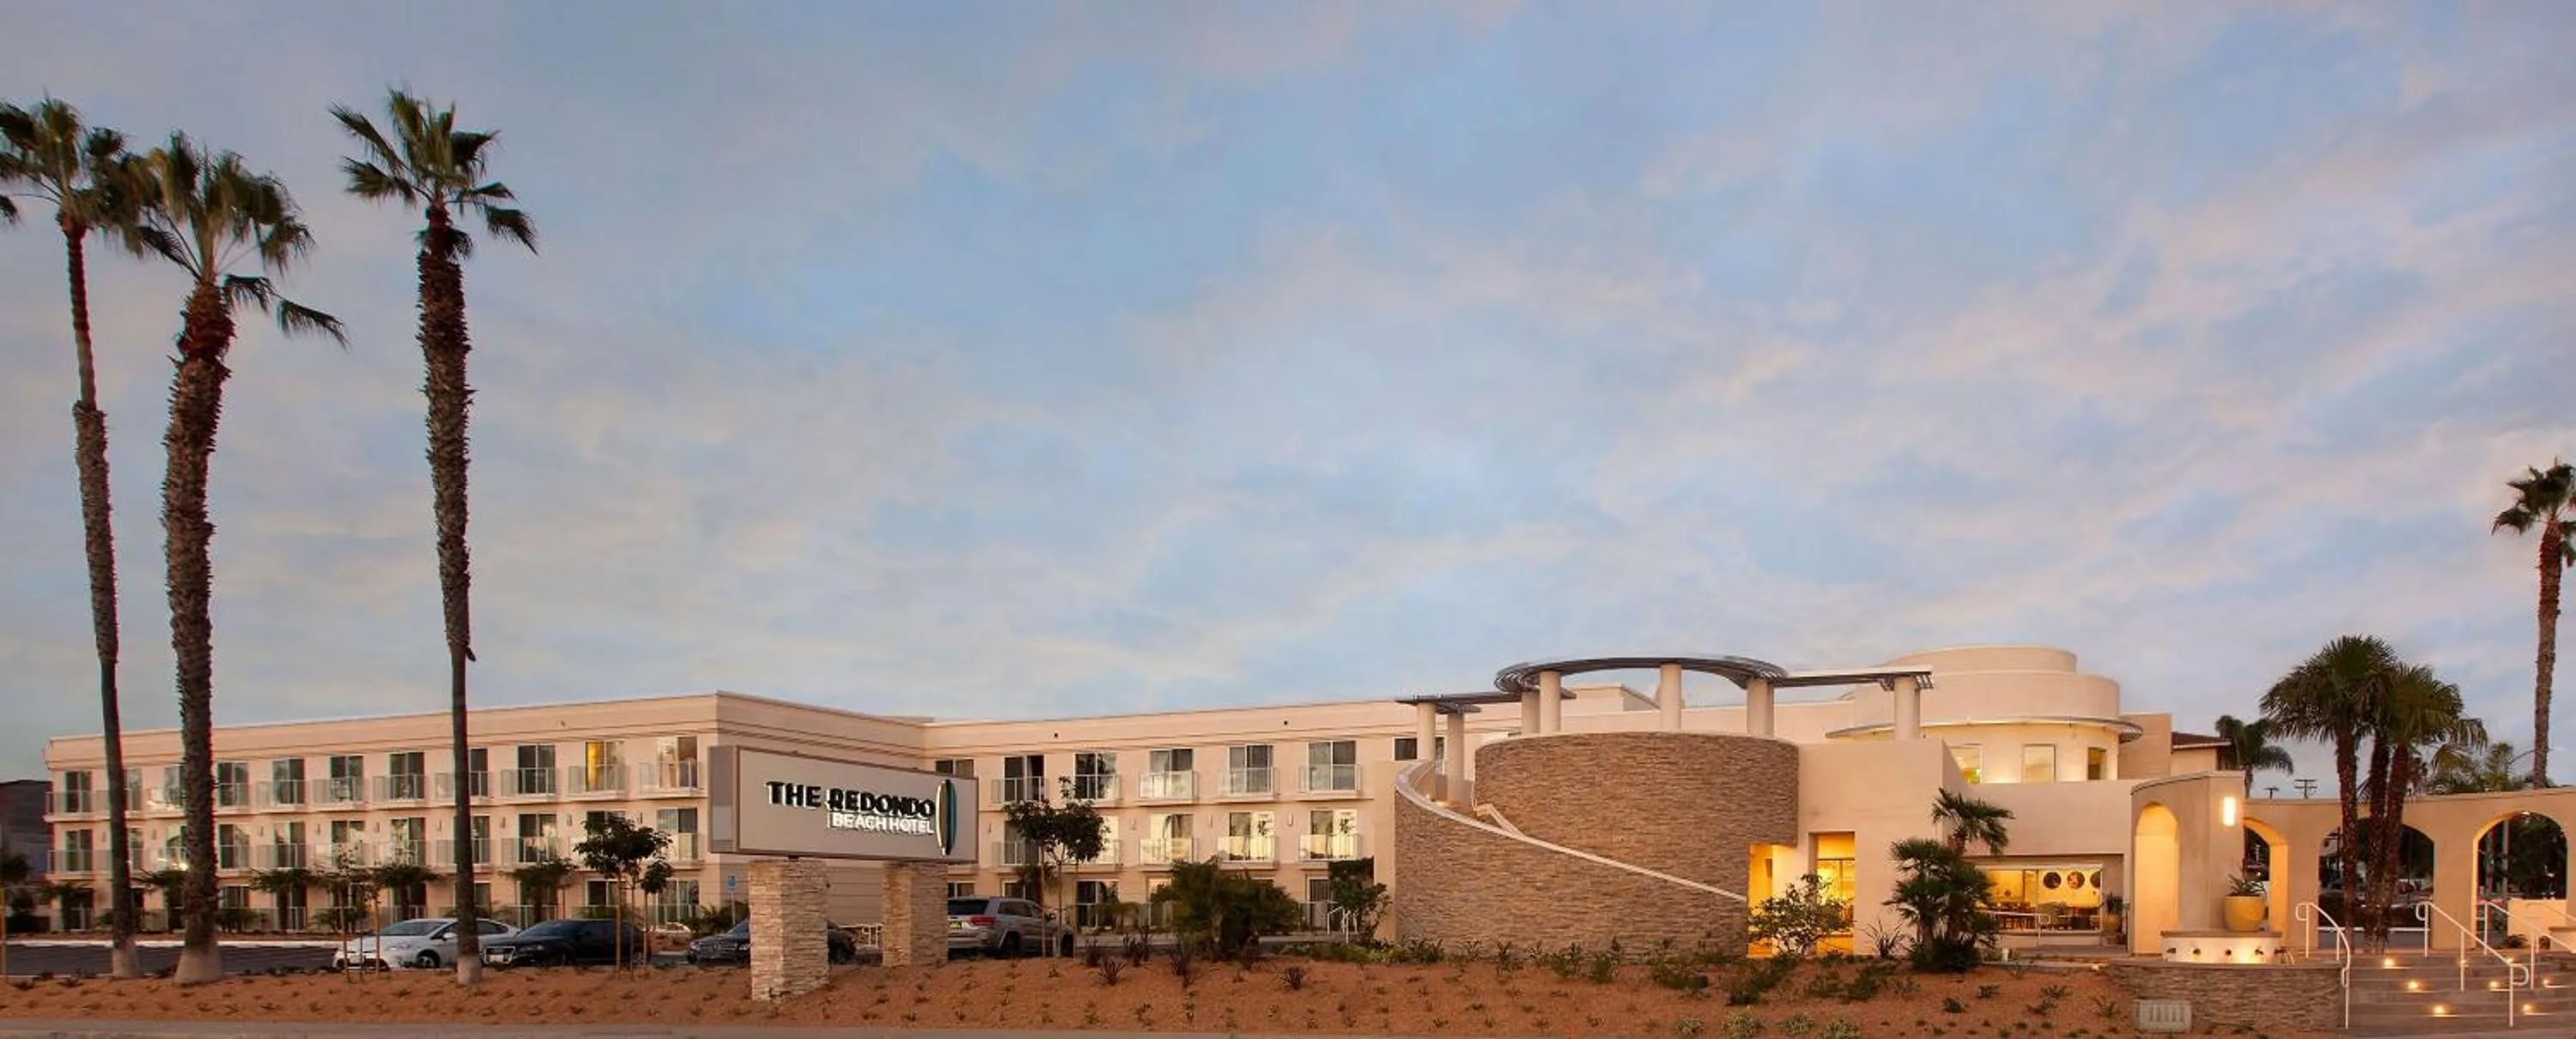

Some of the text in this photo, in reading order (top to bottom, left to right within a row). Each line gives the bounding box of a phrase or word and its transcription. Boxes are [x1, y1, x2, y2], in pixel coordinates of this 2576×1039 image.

[765, 780, 936, 818] THE REDONDO
[829, 811, 934, 835] BEACH HOTEL
